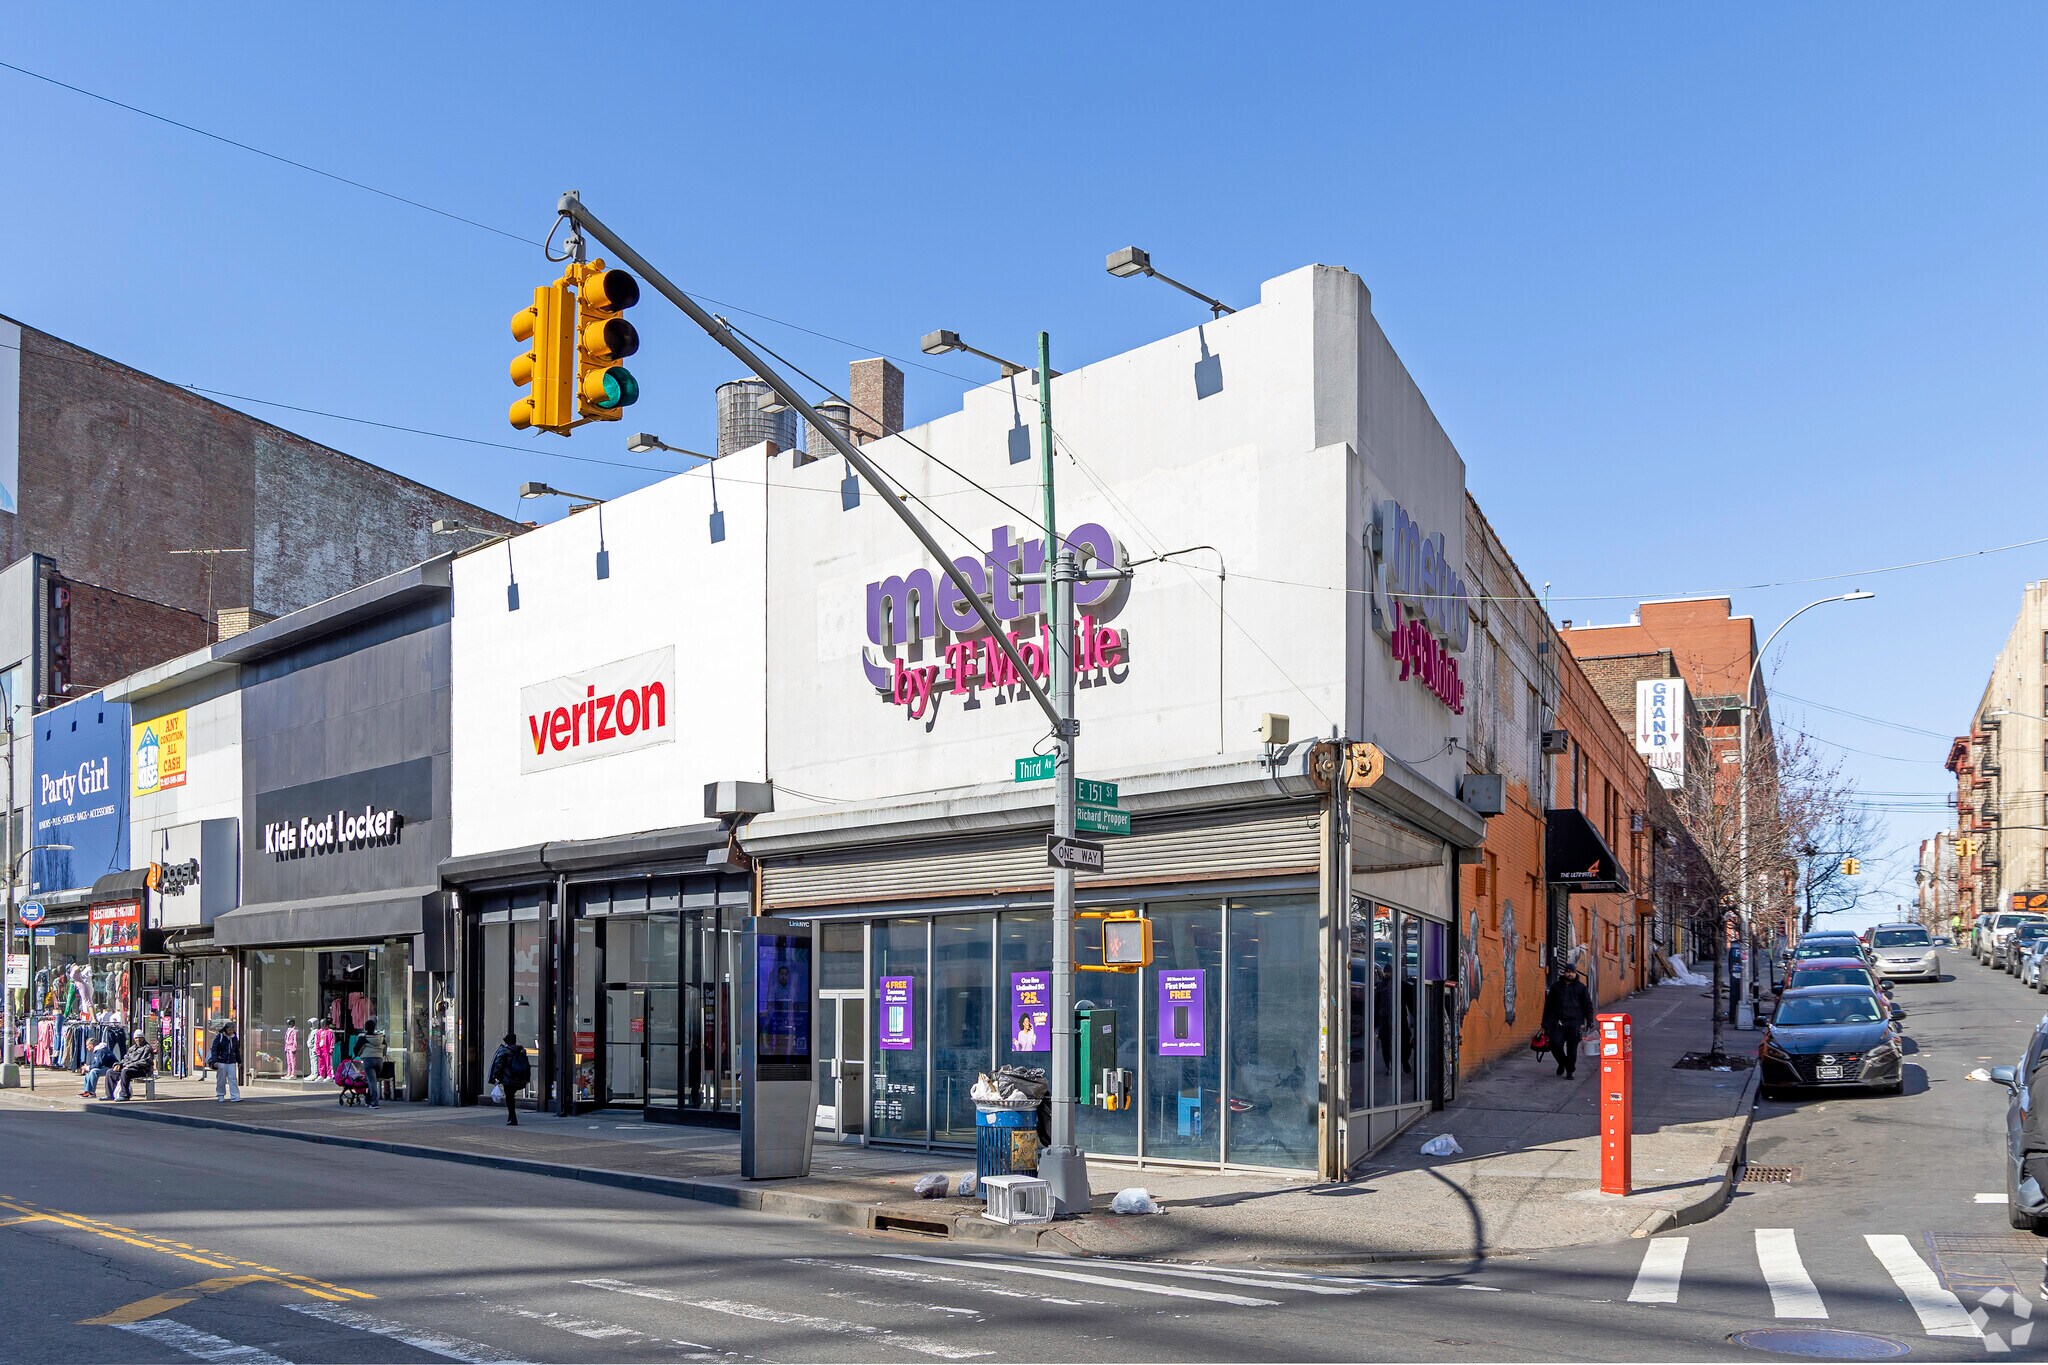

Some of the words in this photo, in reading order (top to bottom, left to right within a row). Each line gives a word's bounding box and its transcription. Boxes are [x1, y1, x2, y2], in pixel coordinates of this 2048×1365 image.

[866, 523, 1118, 646] metro
[1384, 500, 1469, 652] metro
[1392, 601, 1411, 681] by
[894, 658, 936, 719] by
[945, 615, 1121, 696] T-Moile
[529, 681, 665, 755] verizon
[1653, 683, 1667, 746] GRAND
[165, 717, 179, 732] ANY
[167, 743, 177, 755] ALL
[1020, 760, 1041, 778] Third
[1044, 759, 1052, 769] Av
[41, 770, 76, 806] Party
[78, 756, 109, 795] Girl
[1078, 782, 1084, 799] E
[1089, 783, 1102, 802] 151
[1106, 786, 1113, 798] St
[1077, 808, 1101, 822] Richard
[1103, 811, 1128, 826] Propper
[265, 820, 298, 854] Kids
[301, 814, 335, 849] Foot
[338, 805, 396, 842] Locker
[1097, 824, 1109, 832] Way
[1058, 846, 1074, 860] ONE
[1081, 850, 1098, 863] WAY
[891, 980, 907, 989] FREE
[1015, 983, 1037, 991] Unlimited
[1179, 982, 1197, 990] Month
[1169, 990, 1192, 1000] FREE
